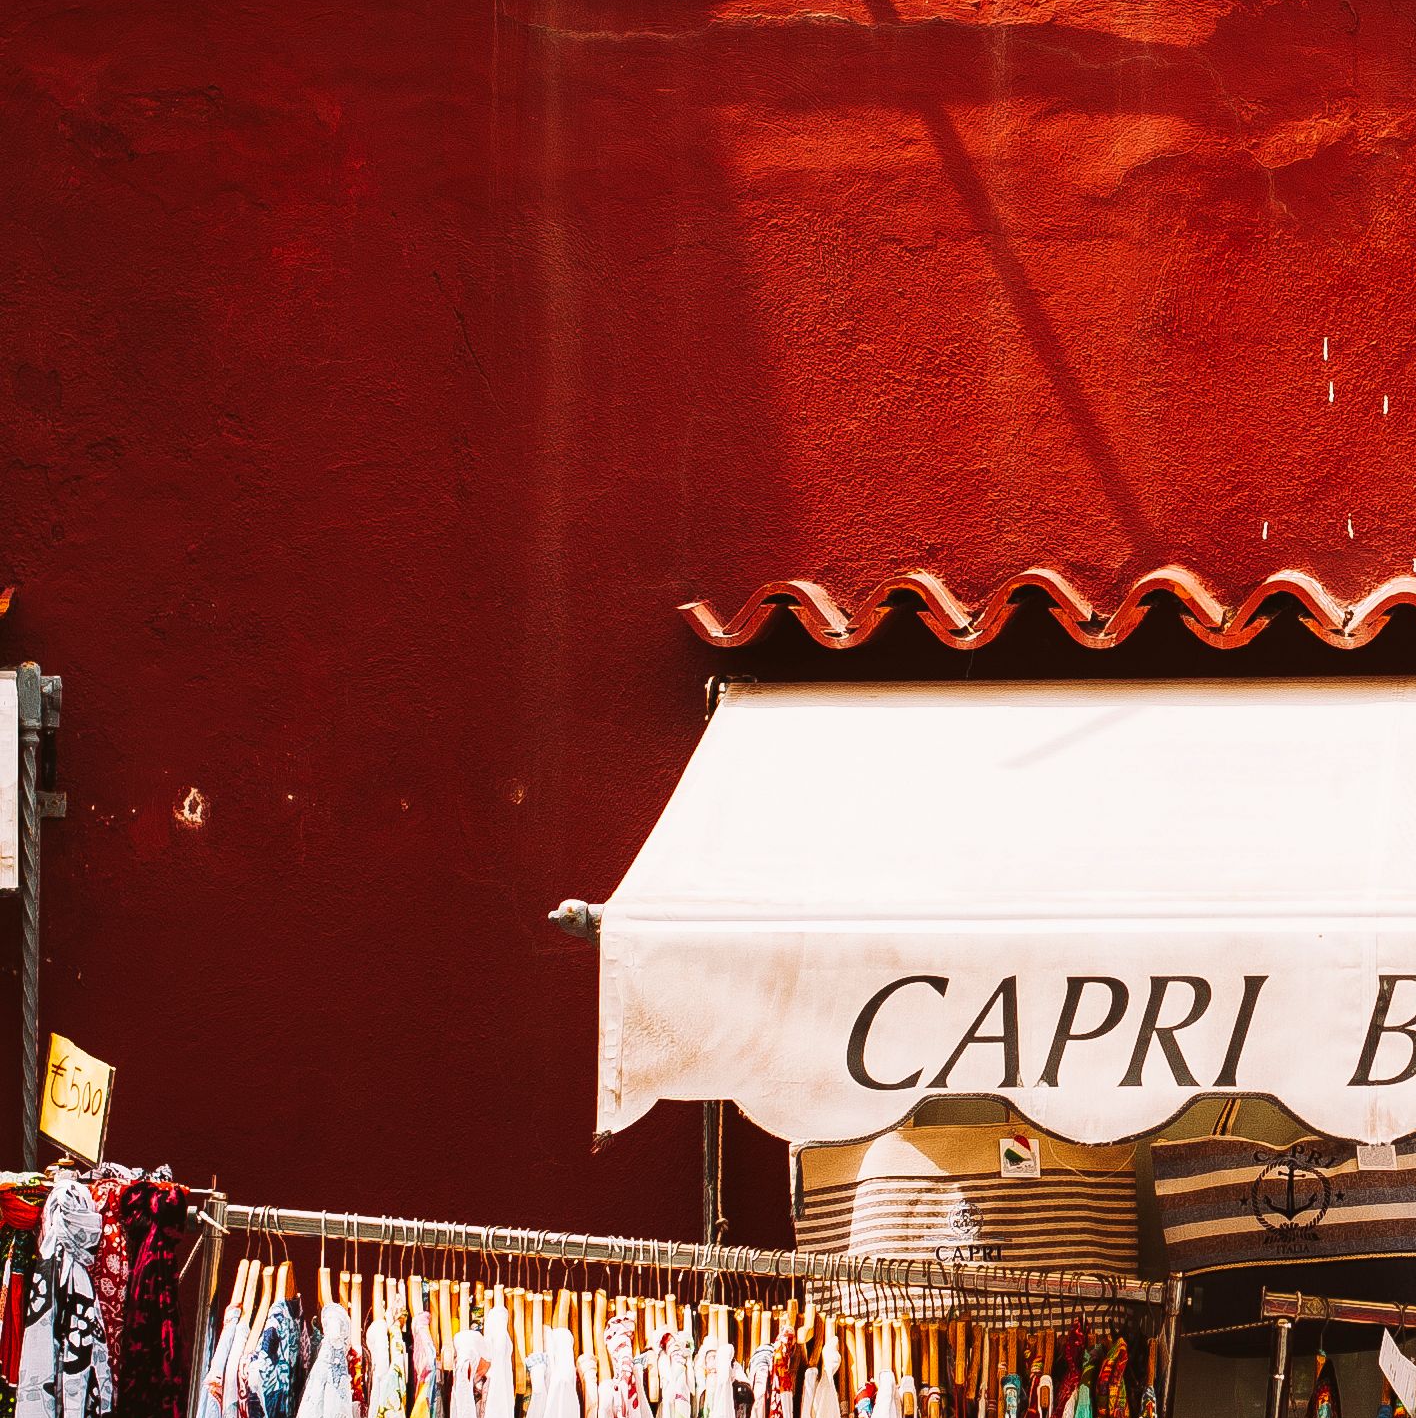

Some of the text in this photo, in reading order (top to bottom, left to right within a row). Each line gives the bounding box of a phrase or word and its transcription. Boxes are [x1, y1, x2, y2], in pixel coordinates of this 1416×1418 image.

[845, 974, 1271, 1092] CAPRI
[50, 1054, 103, 1118] €5,00
[1252, 1144, 1337, 1171] CPRI
[935, 1244, 1003, 1262] CAPRI
